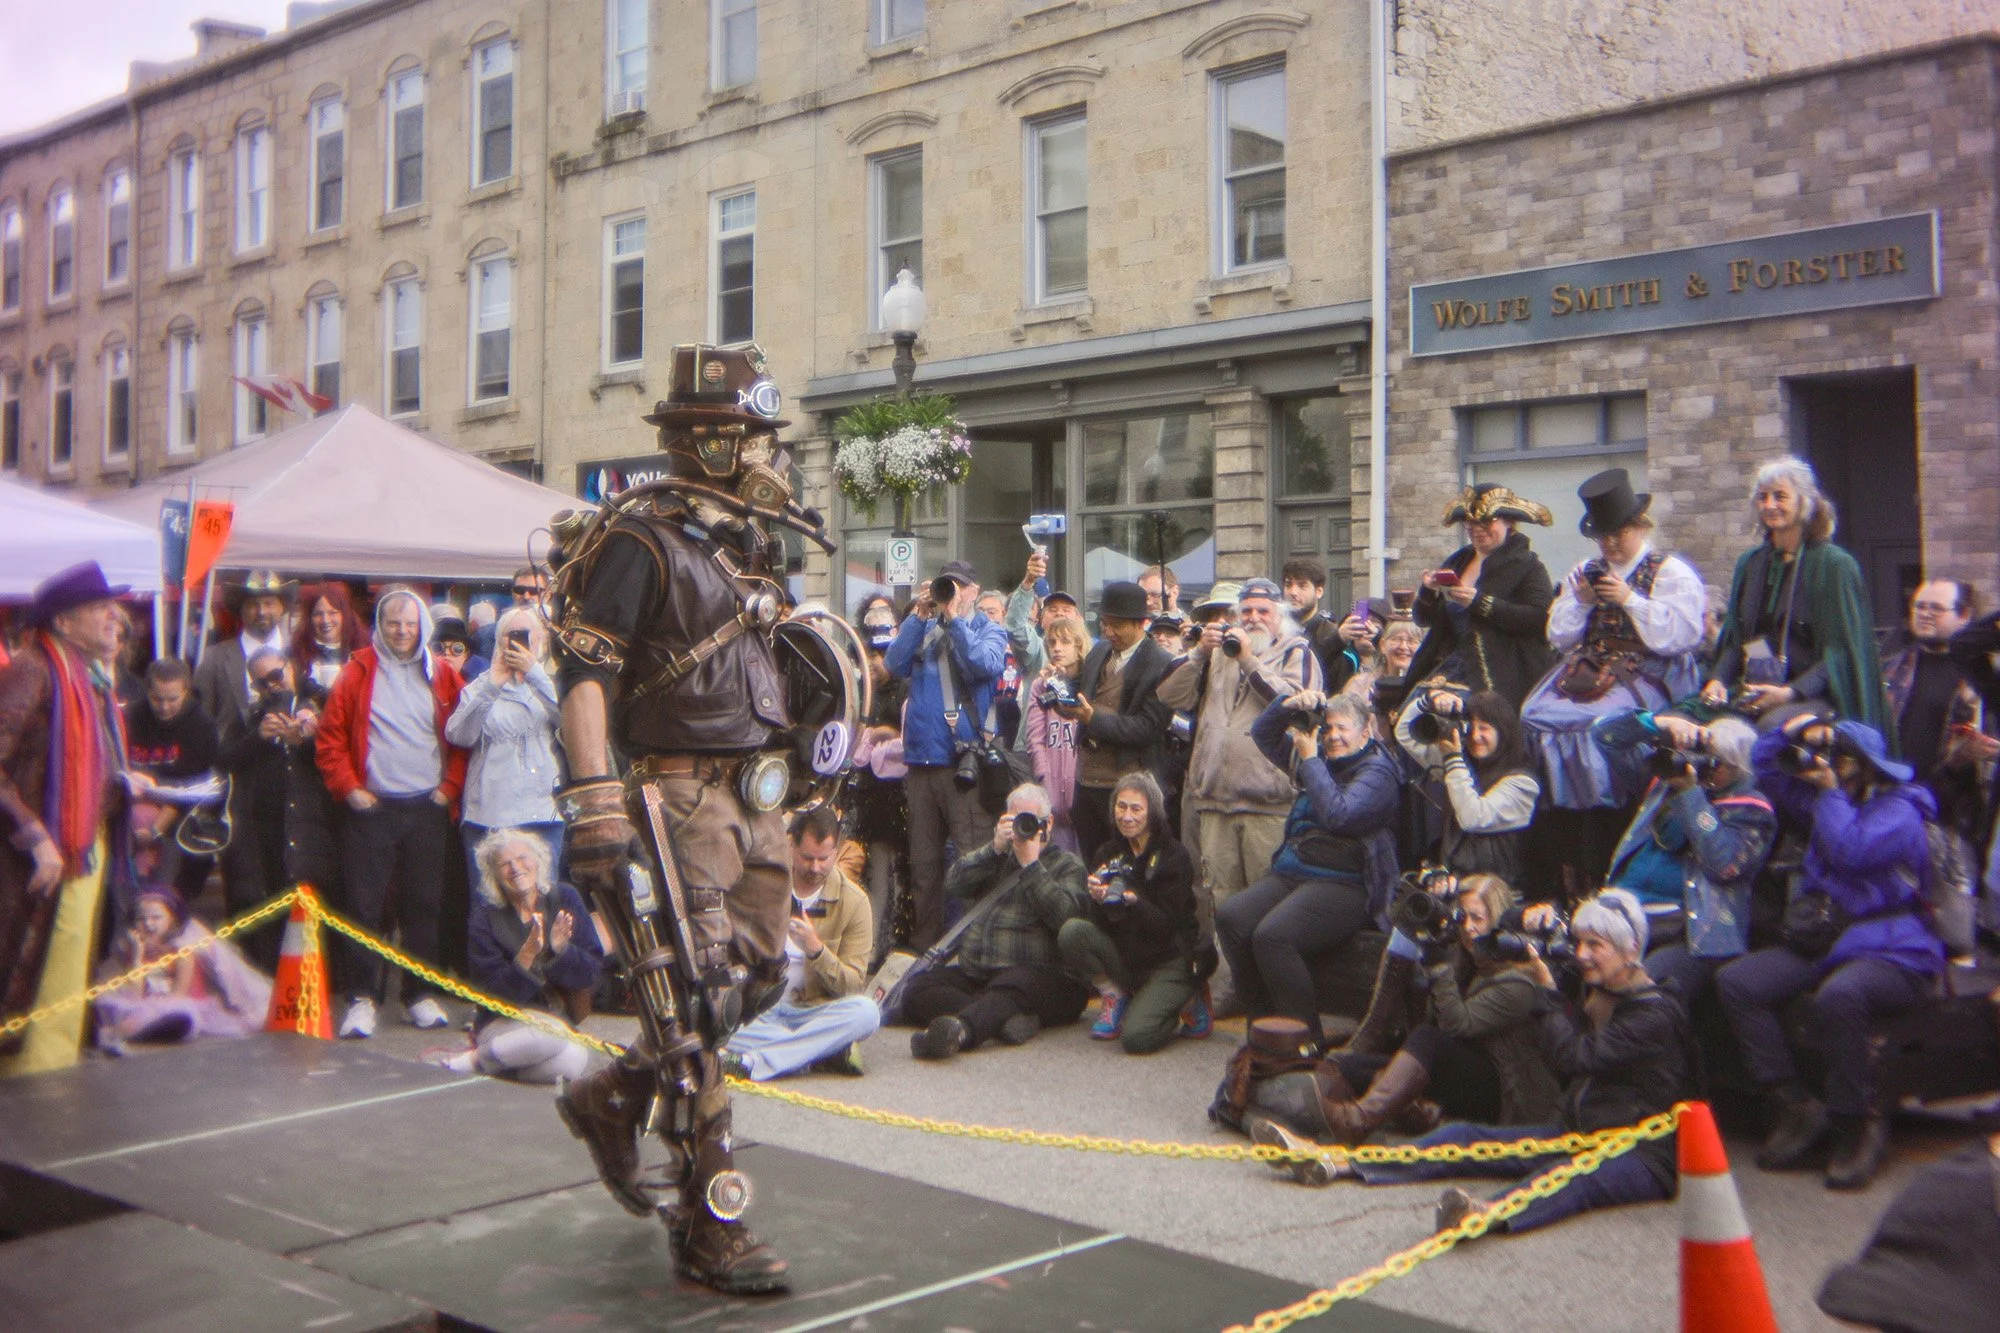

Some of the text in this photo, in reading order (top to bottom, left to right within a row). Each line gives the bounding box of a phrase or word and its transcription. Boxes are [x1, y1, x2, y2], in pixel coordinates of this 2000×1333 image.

[1432, 246, 1907, 330] WOLFE SMITH & FORSTER
[203, 518, 221, 537] 45
[898, 546, 907, 557] P
[816, 729, 836, 765] 22
[1047, 720, 1077, 749] GA
